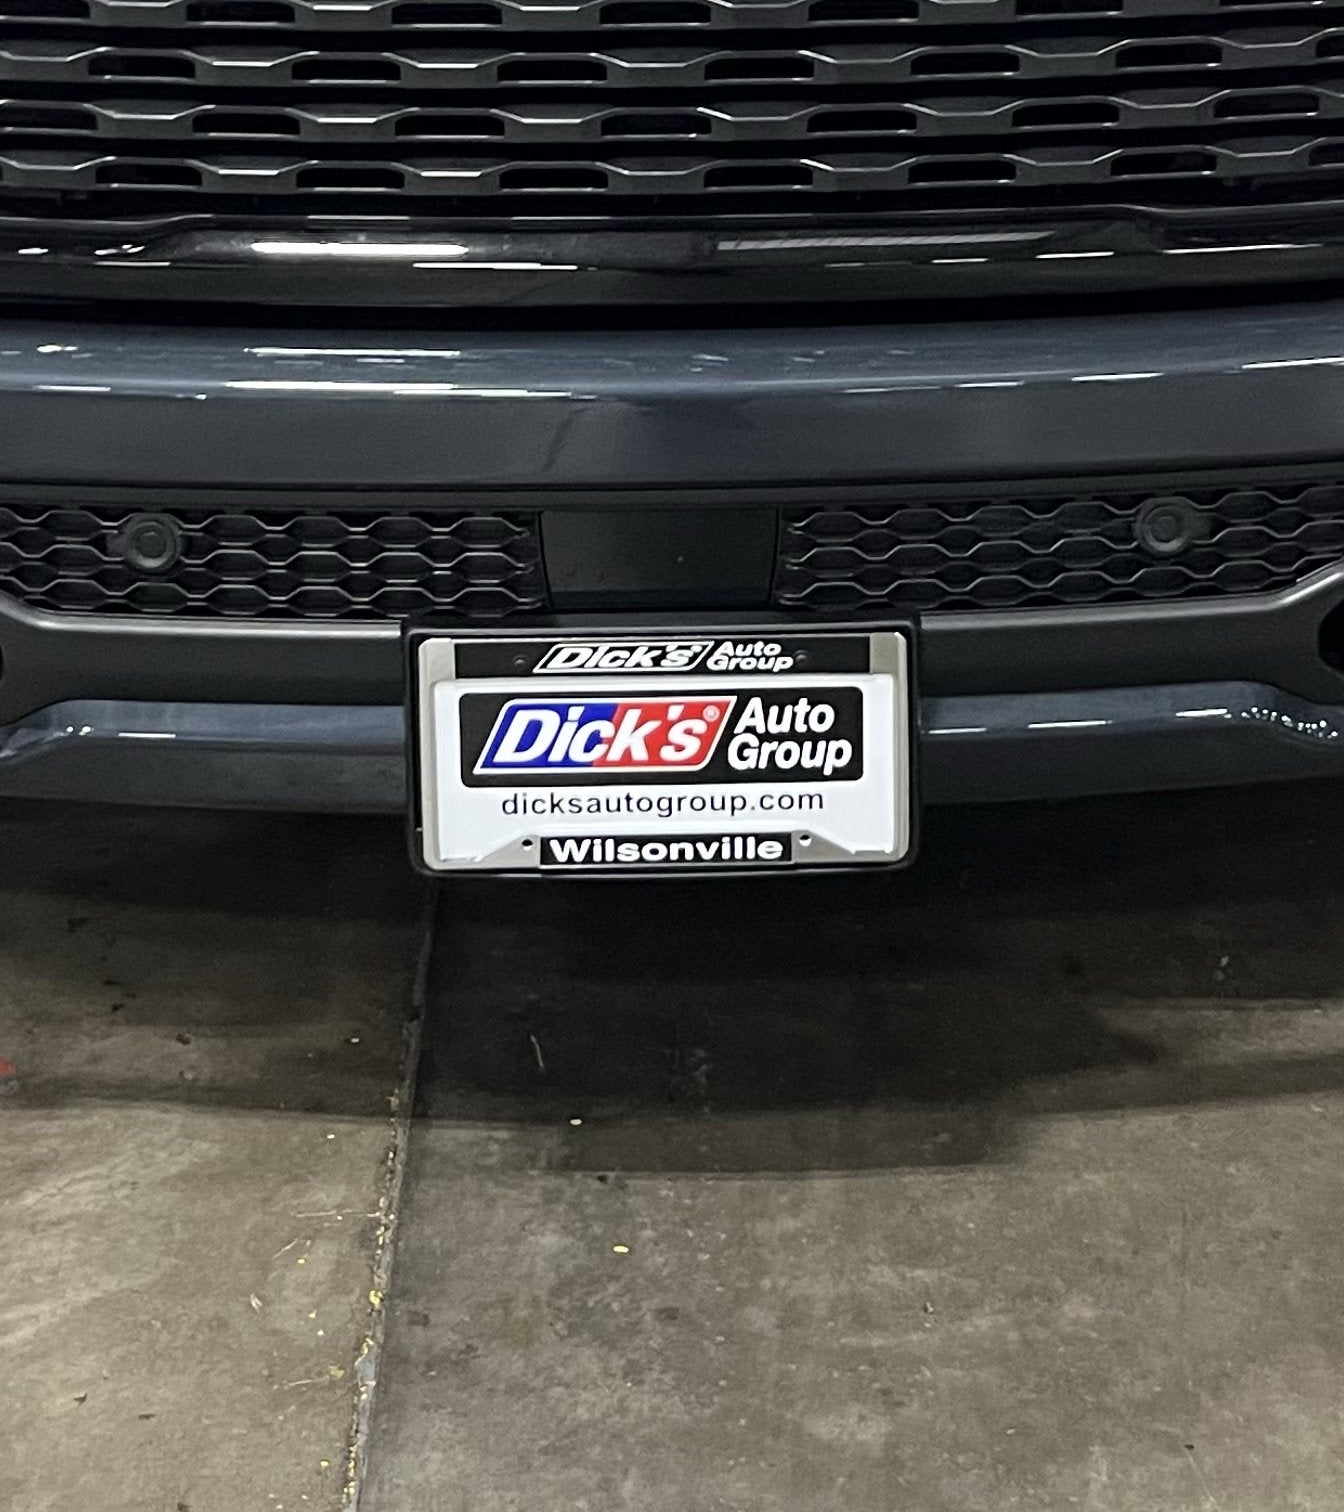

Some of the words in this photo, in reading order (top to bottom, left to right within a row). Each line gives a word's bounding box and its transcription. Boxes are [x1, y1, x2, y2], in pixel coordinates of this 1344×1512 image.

[706, 654, 794, 672] Group
[717, 641, 783, 658] Auto
[733, 697, 836, 735] Auto
[727, 735, 853, 776] Group
[501, 788, 825, 817] dicksautogroup.com
[549, 836, 784, 864] Wilsonville
